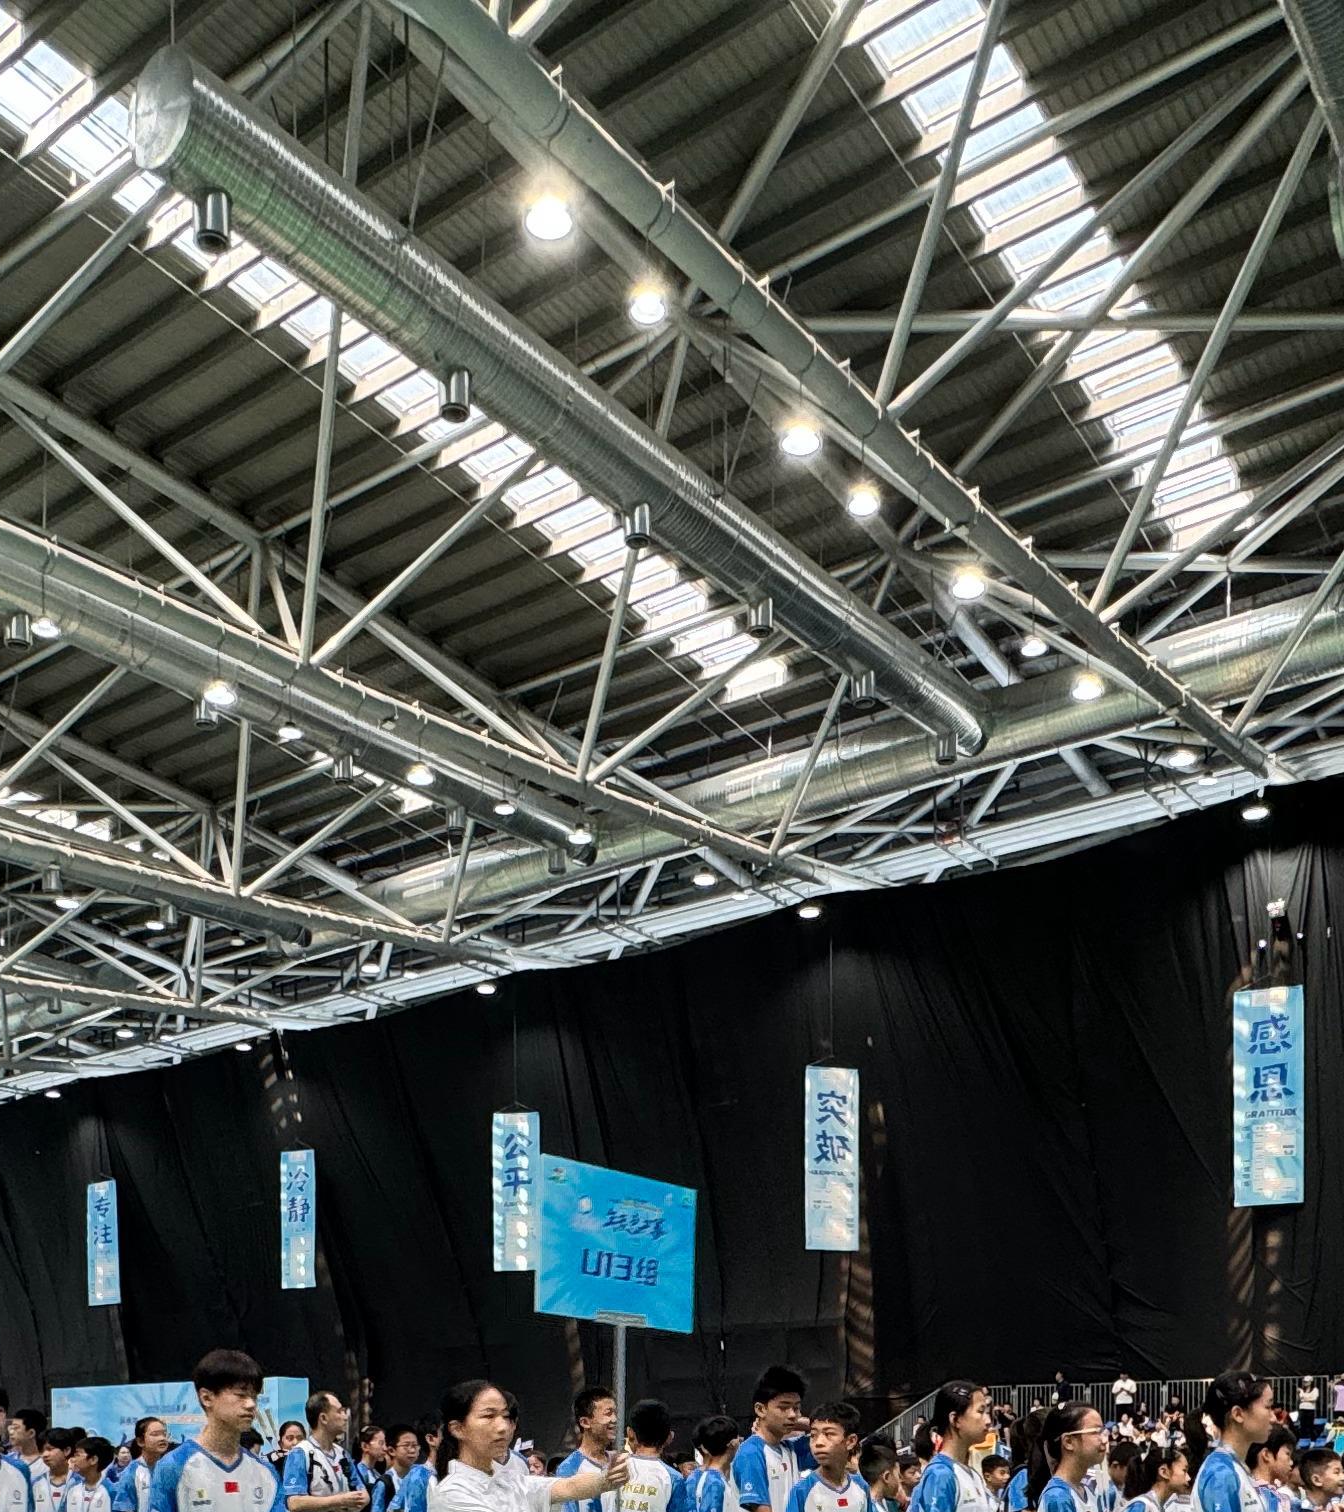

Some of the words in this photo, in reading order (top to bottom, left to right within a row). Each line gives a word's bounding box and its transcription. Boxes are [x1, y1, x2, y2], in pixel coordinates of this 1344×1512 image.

[1246, 1013, 1296, 1103] 感恩
[502, 1132, 533, 1197] 公平
[93, 1196, 113, 1246] 专注
[286, 1167, 311, 1223] 冷静
